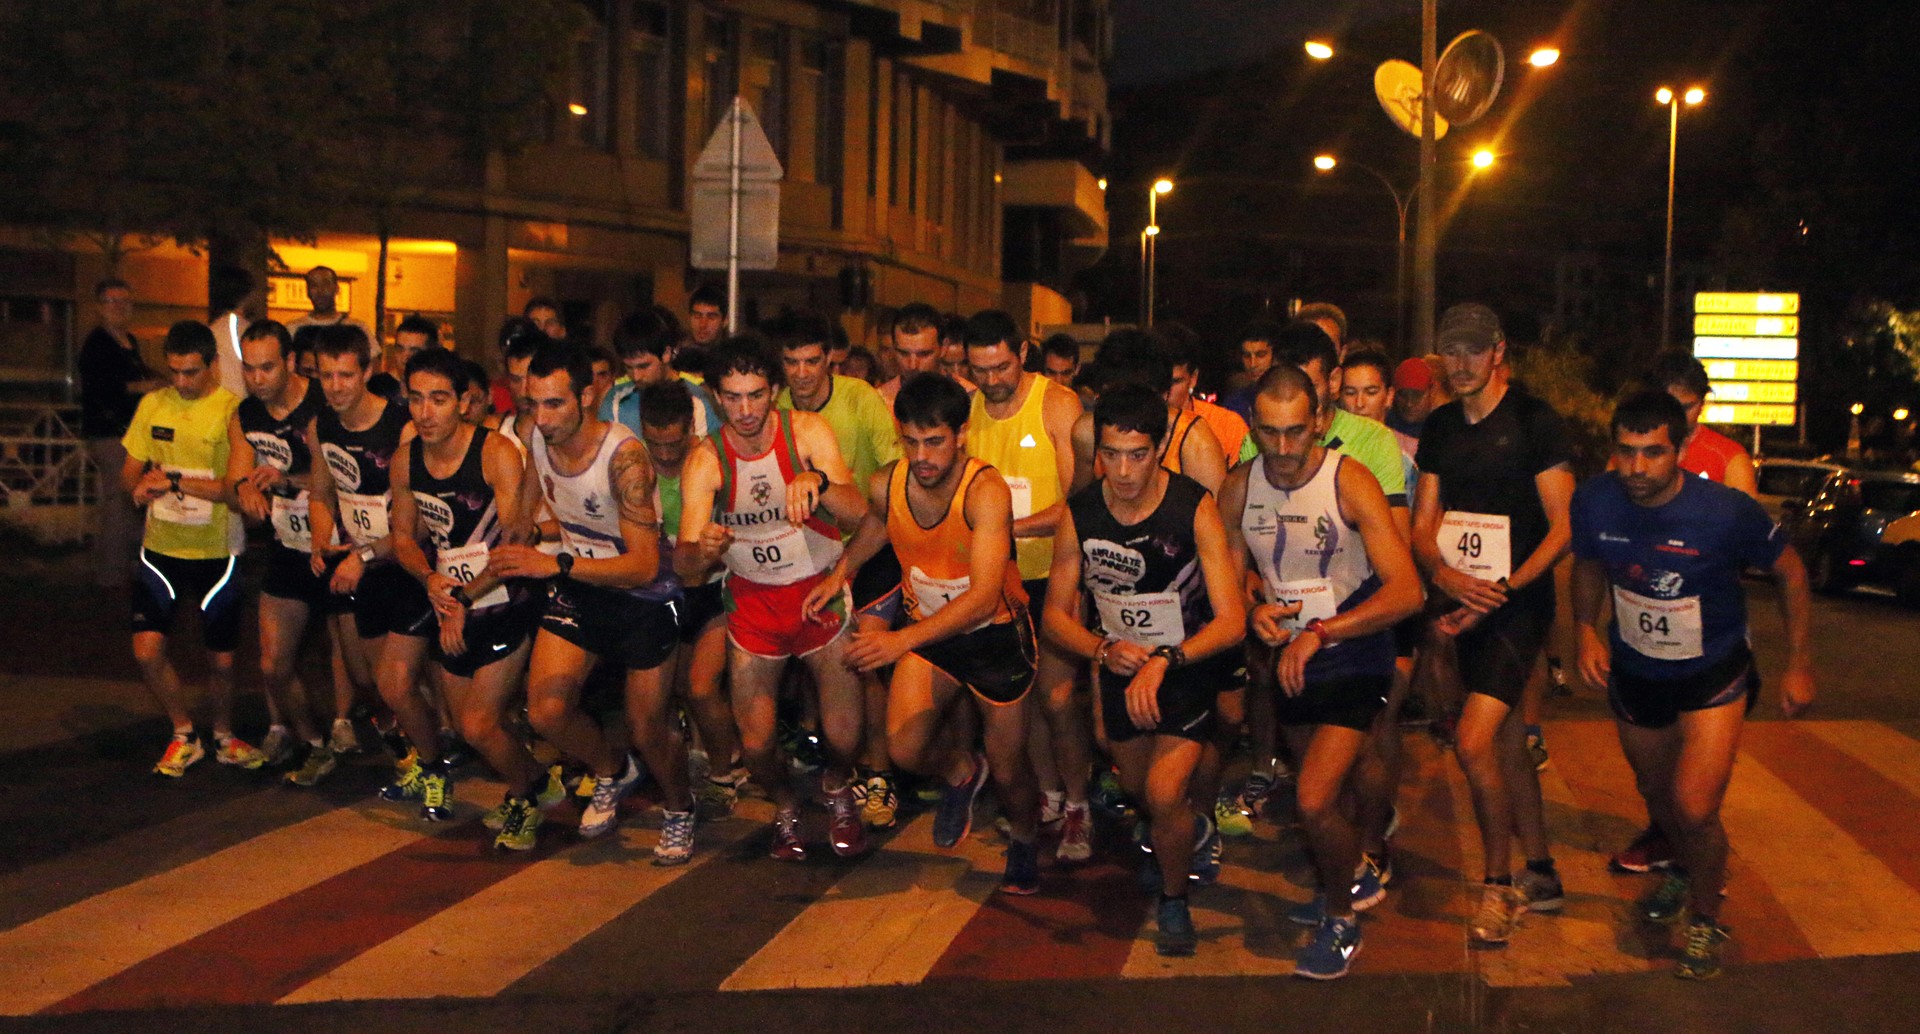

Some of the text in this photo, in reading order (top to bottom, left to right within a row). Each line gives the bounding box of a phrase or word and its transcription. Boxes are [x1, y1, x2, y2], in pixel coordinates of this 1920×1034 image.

[353, 509, 371, 531] 46
[752, 544, 782, 564] 60
[1457, 531, 1482, 558] 49
[1120, 608, 1153, 628] 62
[1639, 611, 1670, 636] 64
